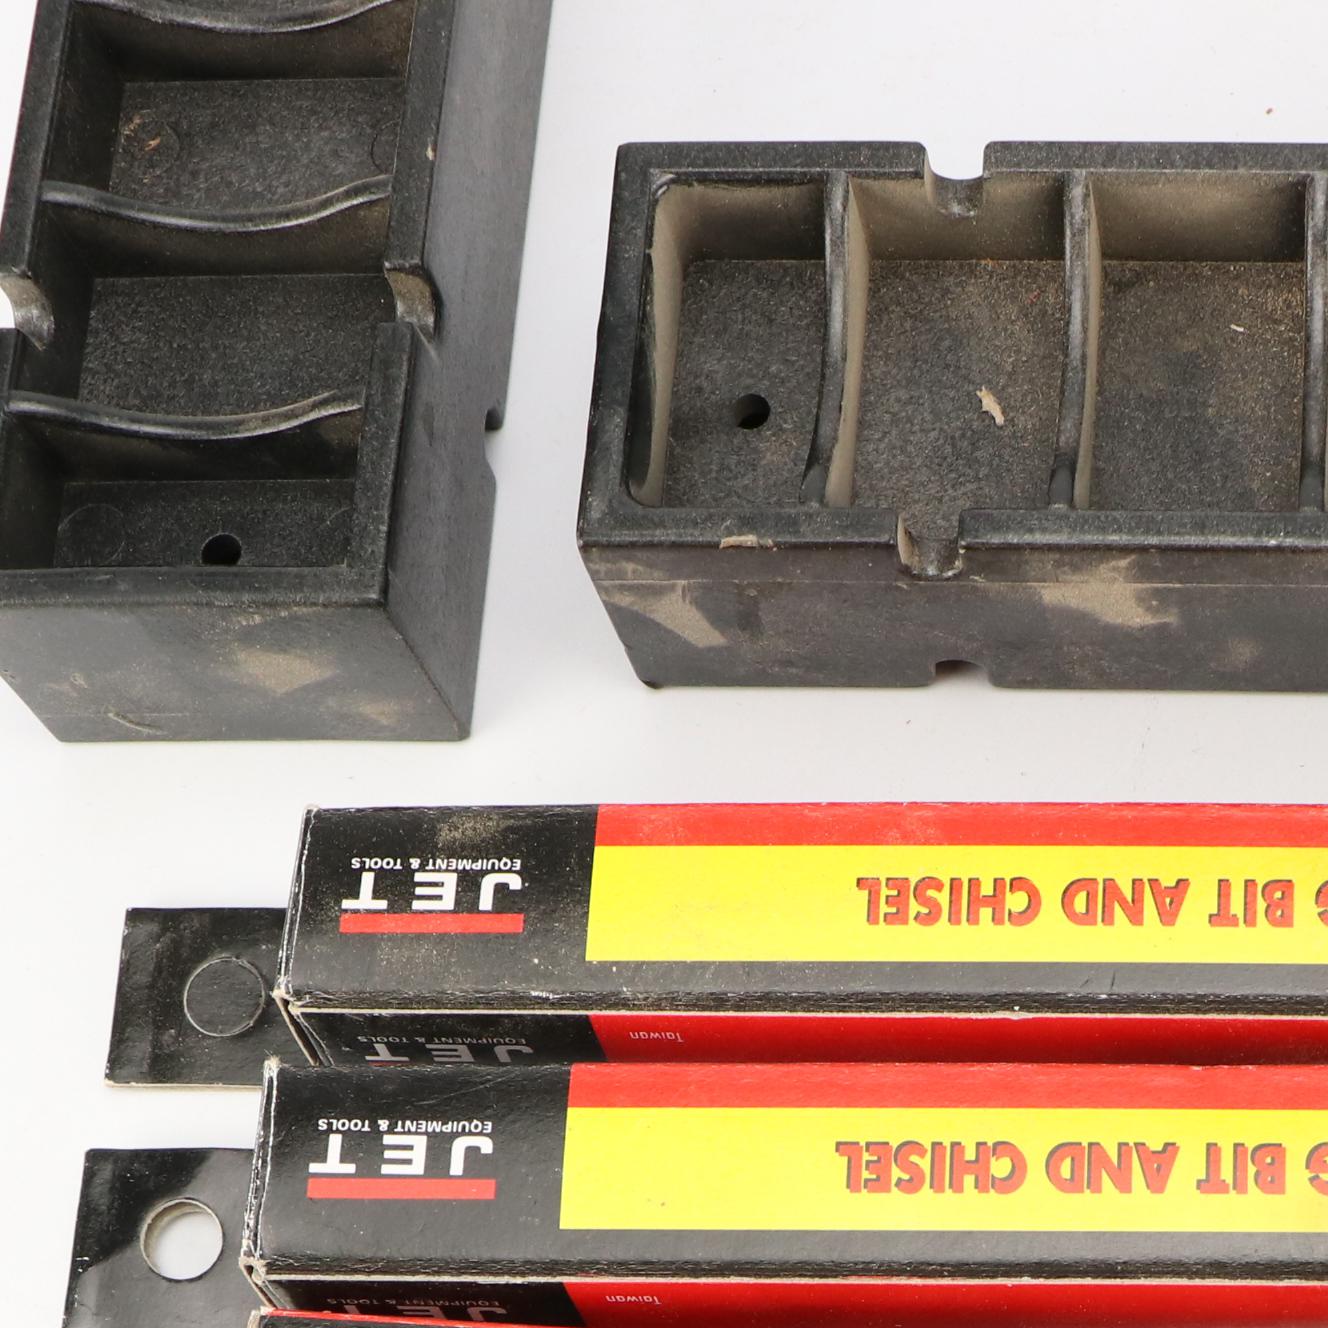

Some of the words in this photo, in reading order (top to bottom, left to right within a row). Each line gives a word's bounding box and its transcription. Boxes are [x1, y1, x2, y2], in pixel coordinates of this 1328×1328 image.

[351, 857, 404, 870] TOOLS
[409, 857, 421, 871] &
[423, 858, 522, 872] EQUIPMENT
[340, 871, 523, 912] JET
[856, 875, 1042, 927] CHISEL
[1061, 877, 1191, 927] AND
[1208, 878, 1295, 928] BIT
[357, 1035, 408, 1043] TOOLS
[629, 1030, 684, 1043] Taiwan
[364, 1043, 534, 1064] JET
[317, 1118, 371, 1131] TOOLS
[378, 1119, 390, 1131] &
[396, 1119, 493, 1133] EQUIPMENT
[308, 1134, 495, 1175] JET
[835, 1139, 1028, 1195] CHISEL
[1045, 1141, 1180, 1195] AND
[1196, 1141, 1287, 1195] BIT
[606, 1294, 661, 1305] Taiwan
